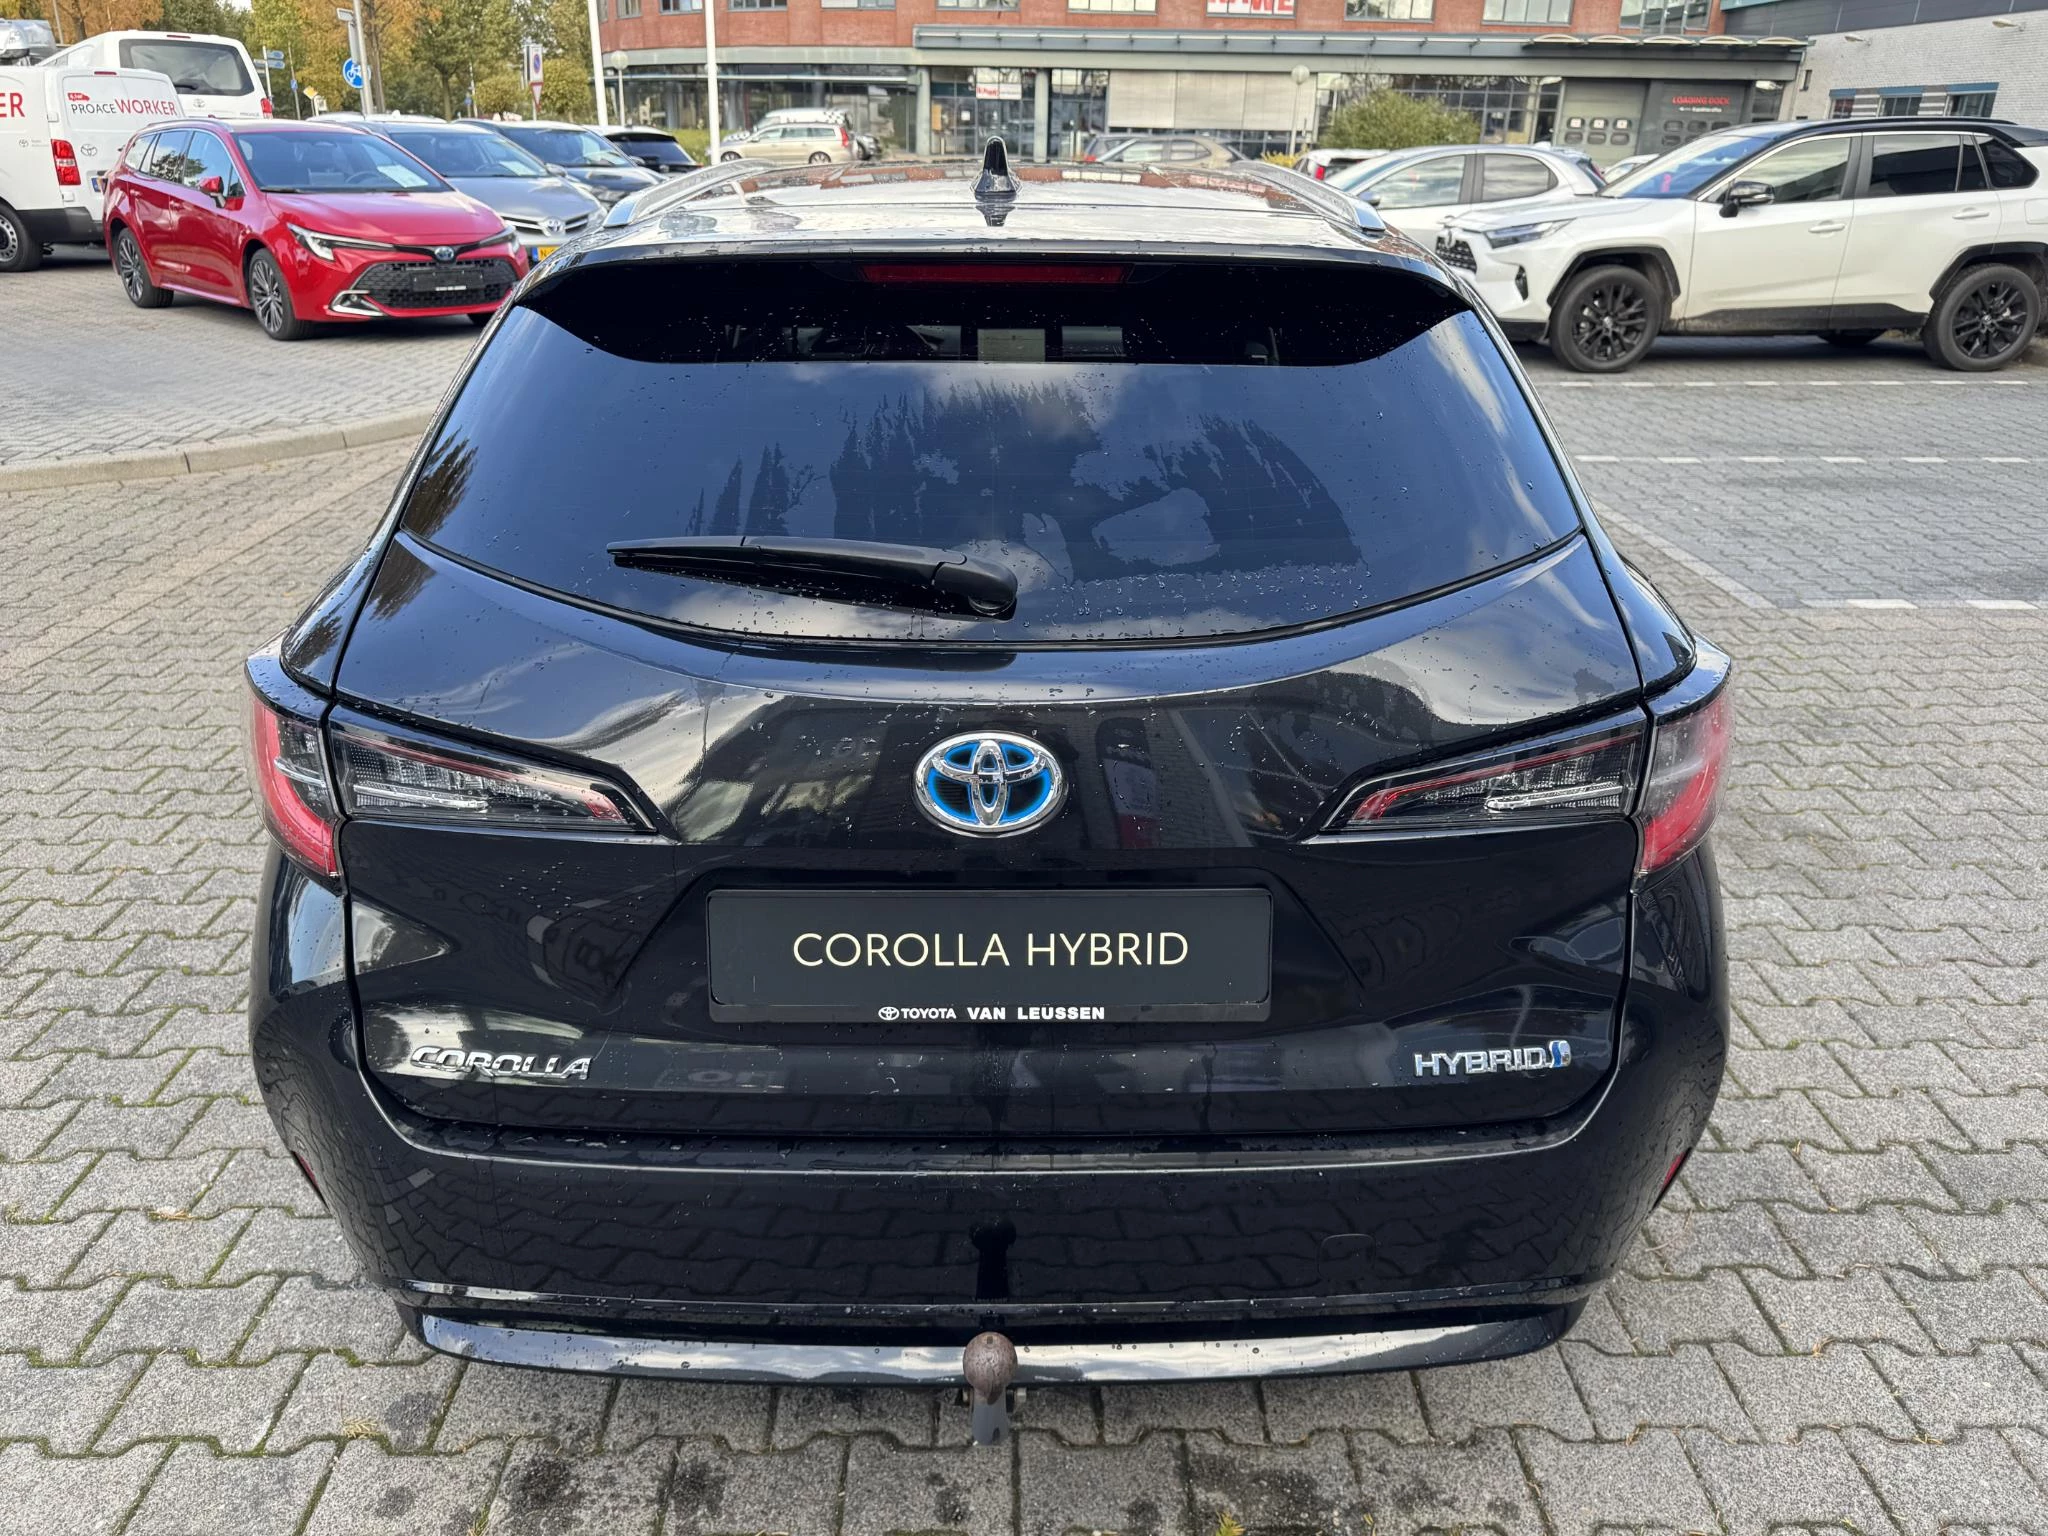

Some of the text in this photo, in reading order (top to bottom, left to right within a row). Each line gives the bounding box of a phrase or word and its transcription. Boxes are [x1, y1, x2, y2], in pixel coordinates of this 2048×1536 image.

[792, 932, 1189, 967] COROLLA HYBRID
[901, 1007, 1105, 1020] TOYOTA VAN LEUSSEN
[410, 1045, 593, 1080] COROLLA
[1414, 1047, 1547, 1077] HYBRID
